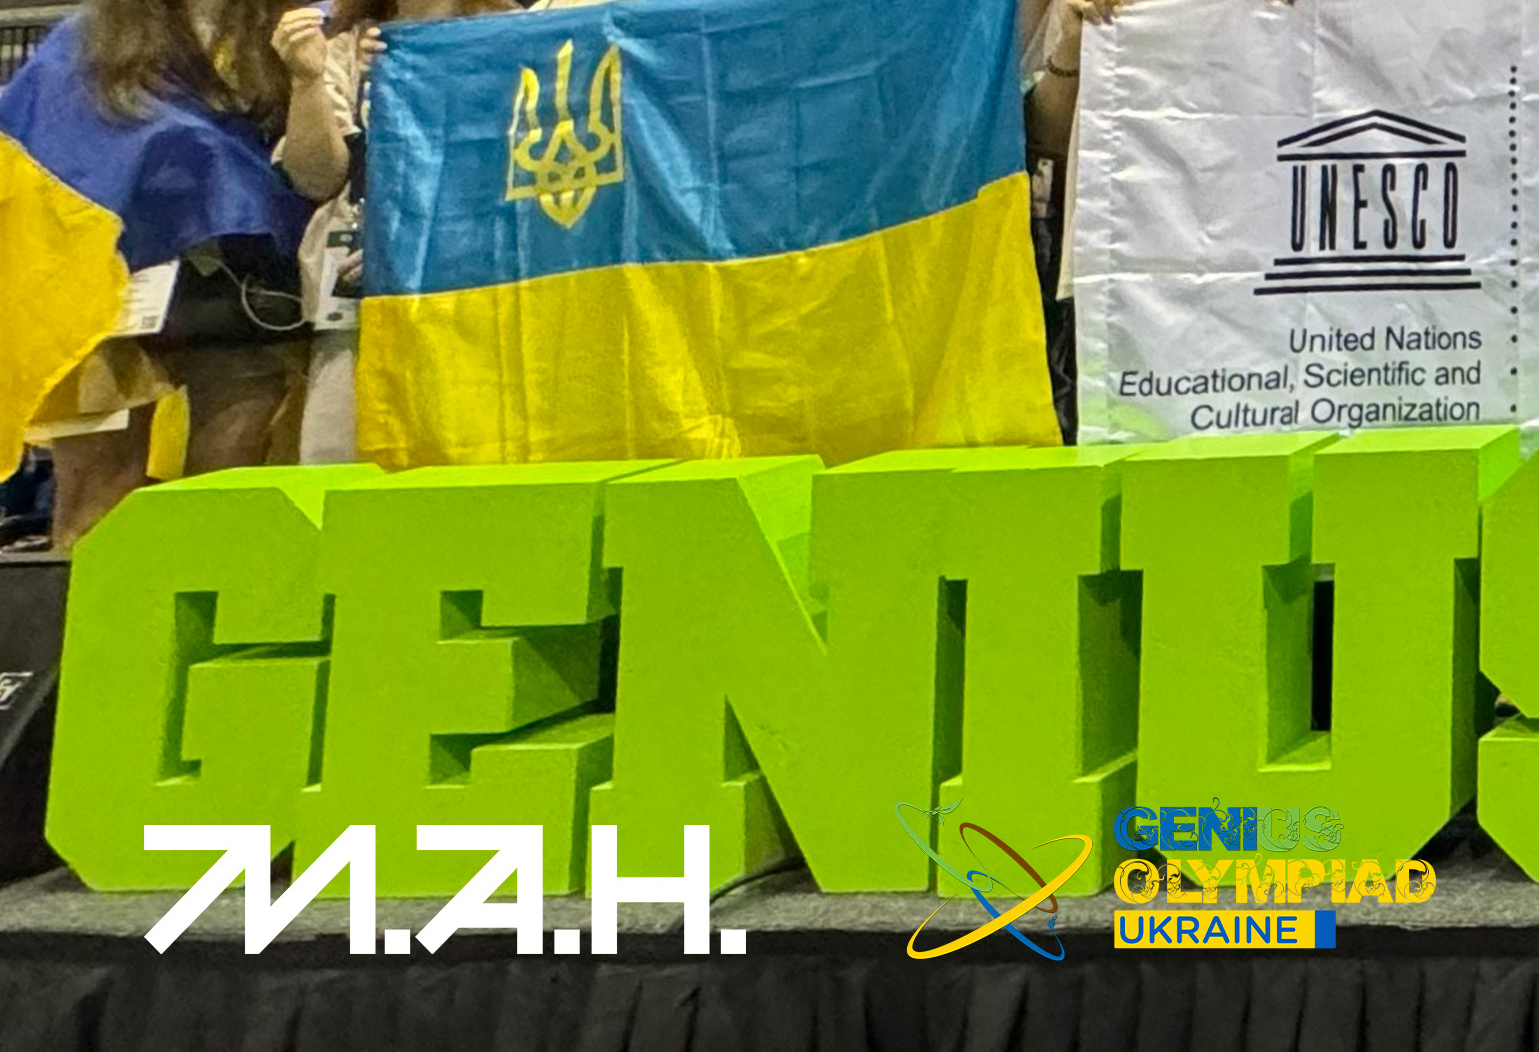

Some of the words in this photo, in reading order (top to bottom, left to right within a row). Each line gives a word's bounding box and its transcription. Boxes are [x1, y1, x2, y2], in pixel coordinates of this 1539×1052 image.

[1290, 161, 1459, 252] UNESCO
[1290, 326, 1375, 354] United
[1385, 325, 1482, 351] Nations
[1119, 365, 1296, 397] Educational,
[1303, 361, 1426, 390] Scientific
[1434, 360, 1482, 386] and
[1190, 401, 1300, 431] Cultural
[1310, 396, 1481, 429] Organization
